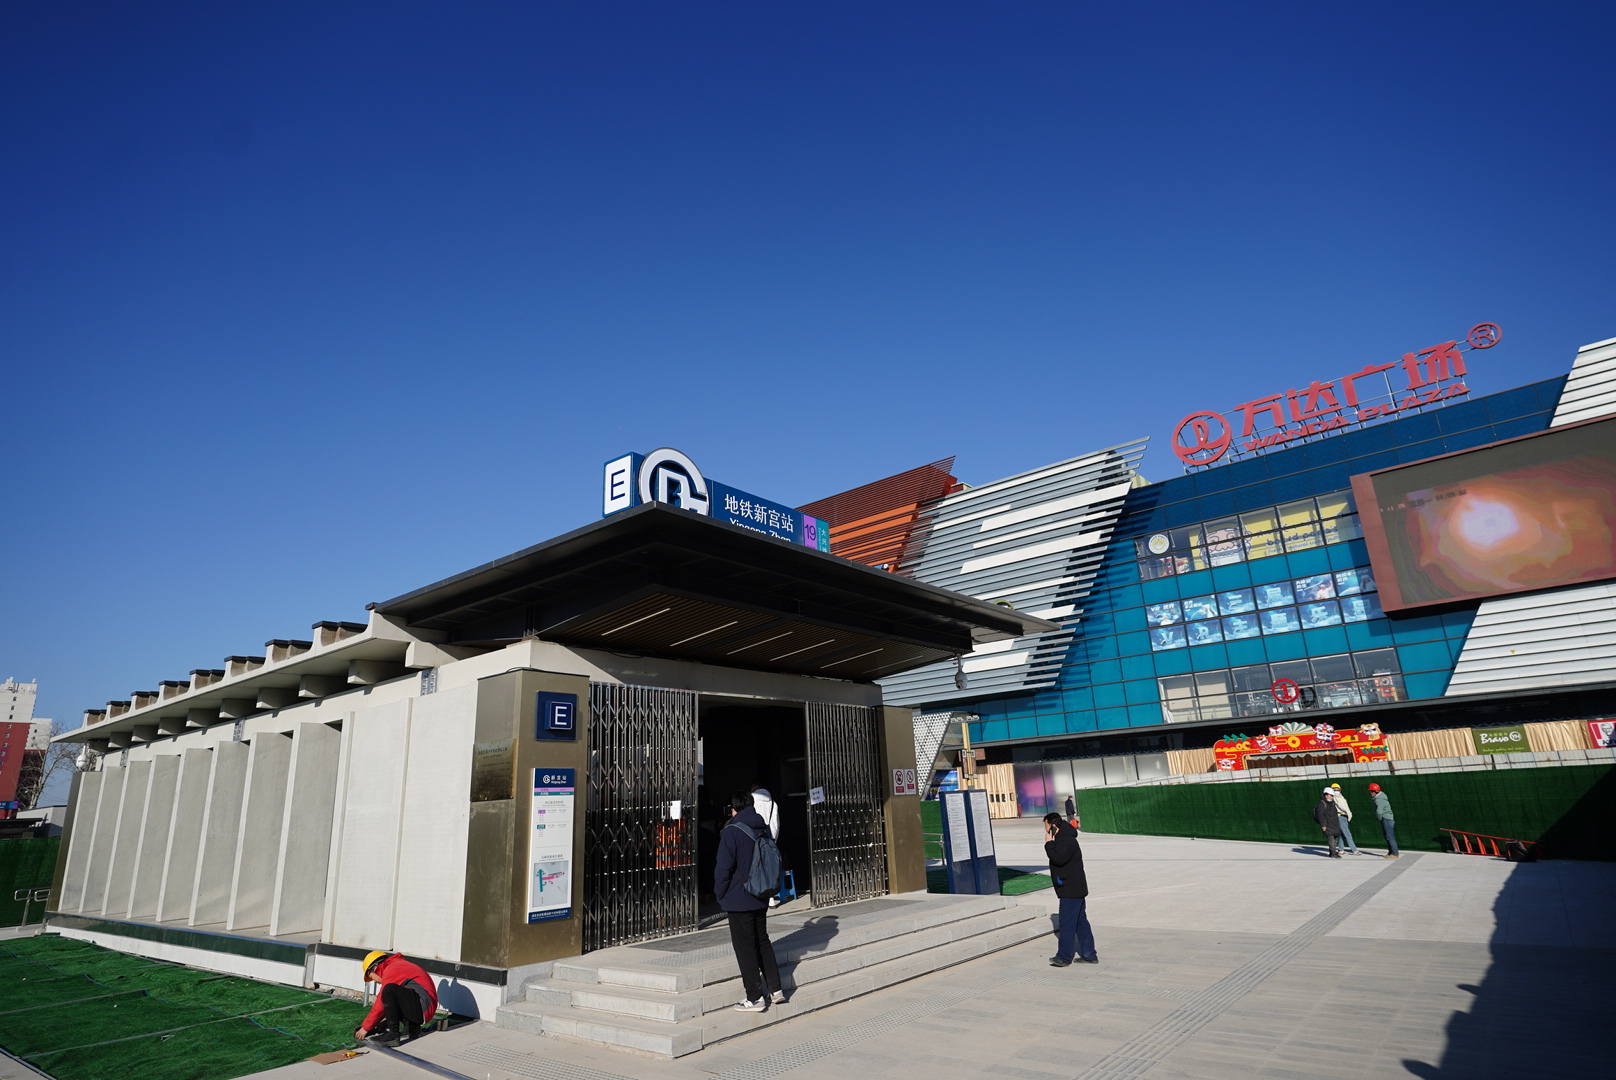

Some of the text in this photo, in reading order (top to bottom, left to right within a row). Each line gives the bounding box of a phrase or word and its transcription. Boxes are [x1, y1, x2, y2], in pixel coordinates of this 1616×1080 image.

[1233, 340, 1468, 437] 万达广场
[1241, 382, 1471, 452] WANDA PLAZA
[610, 468, 626, 501] E
[724, 493, 794, 534] 地铁新宫站
[804, 523, 817, 541] 19
[554, 705, 568, 726] E
[1479, 733, 1509, 744] Bravo
